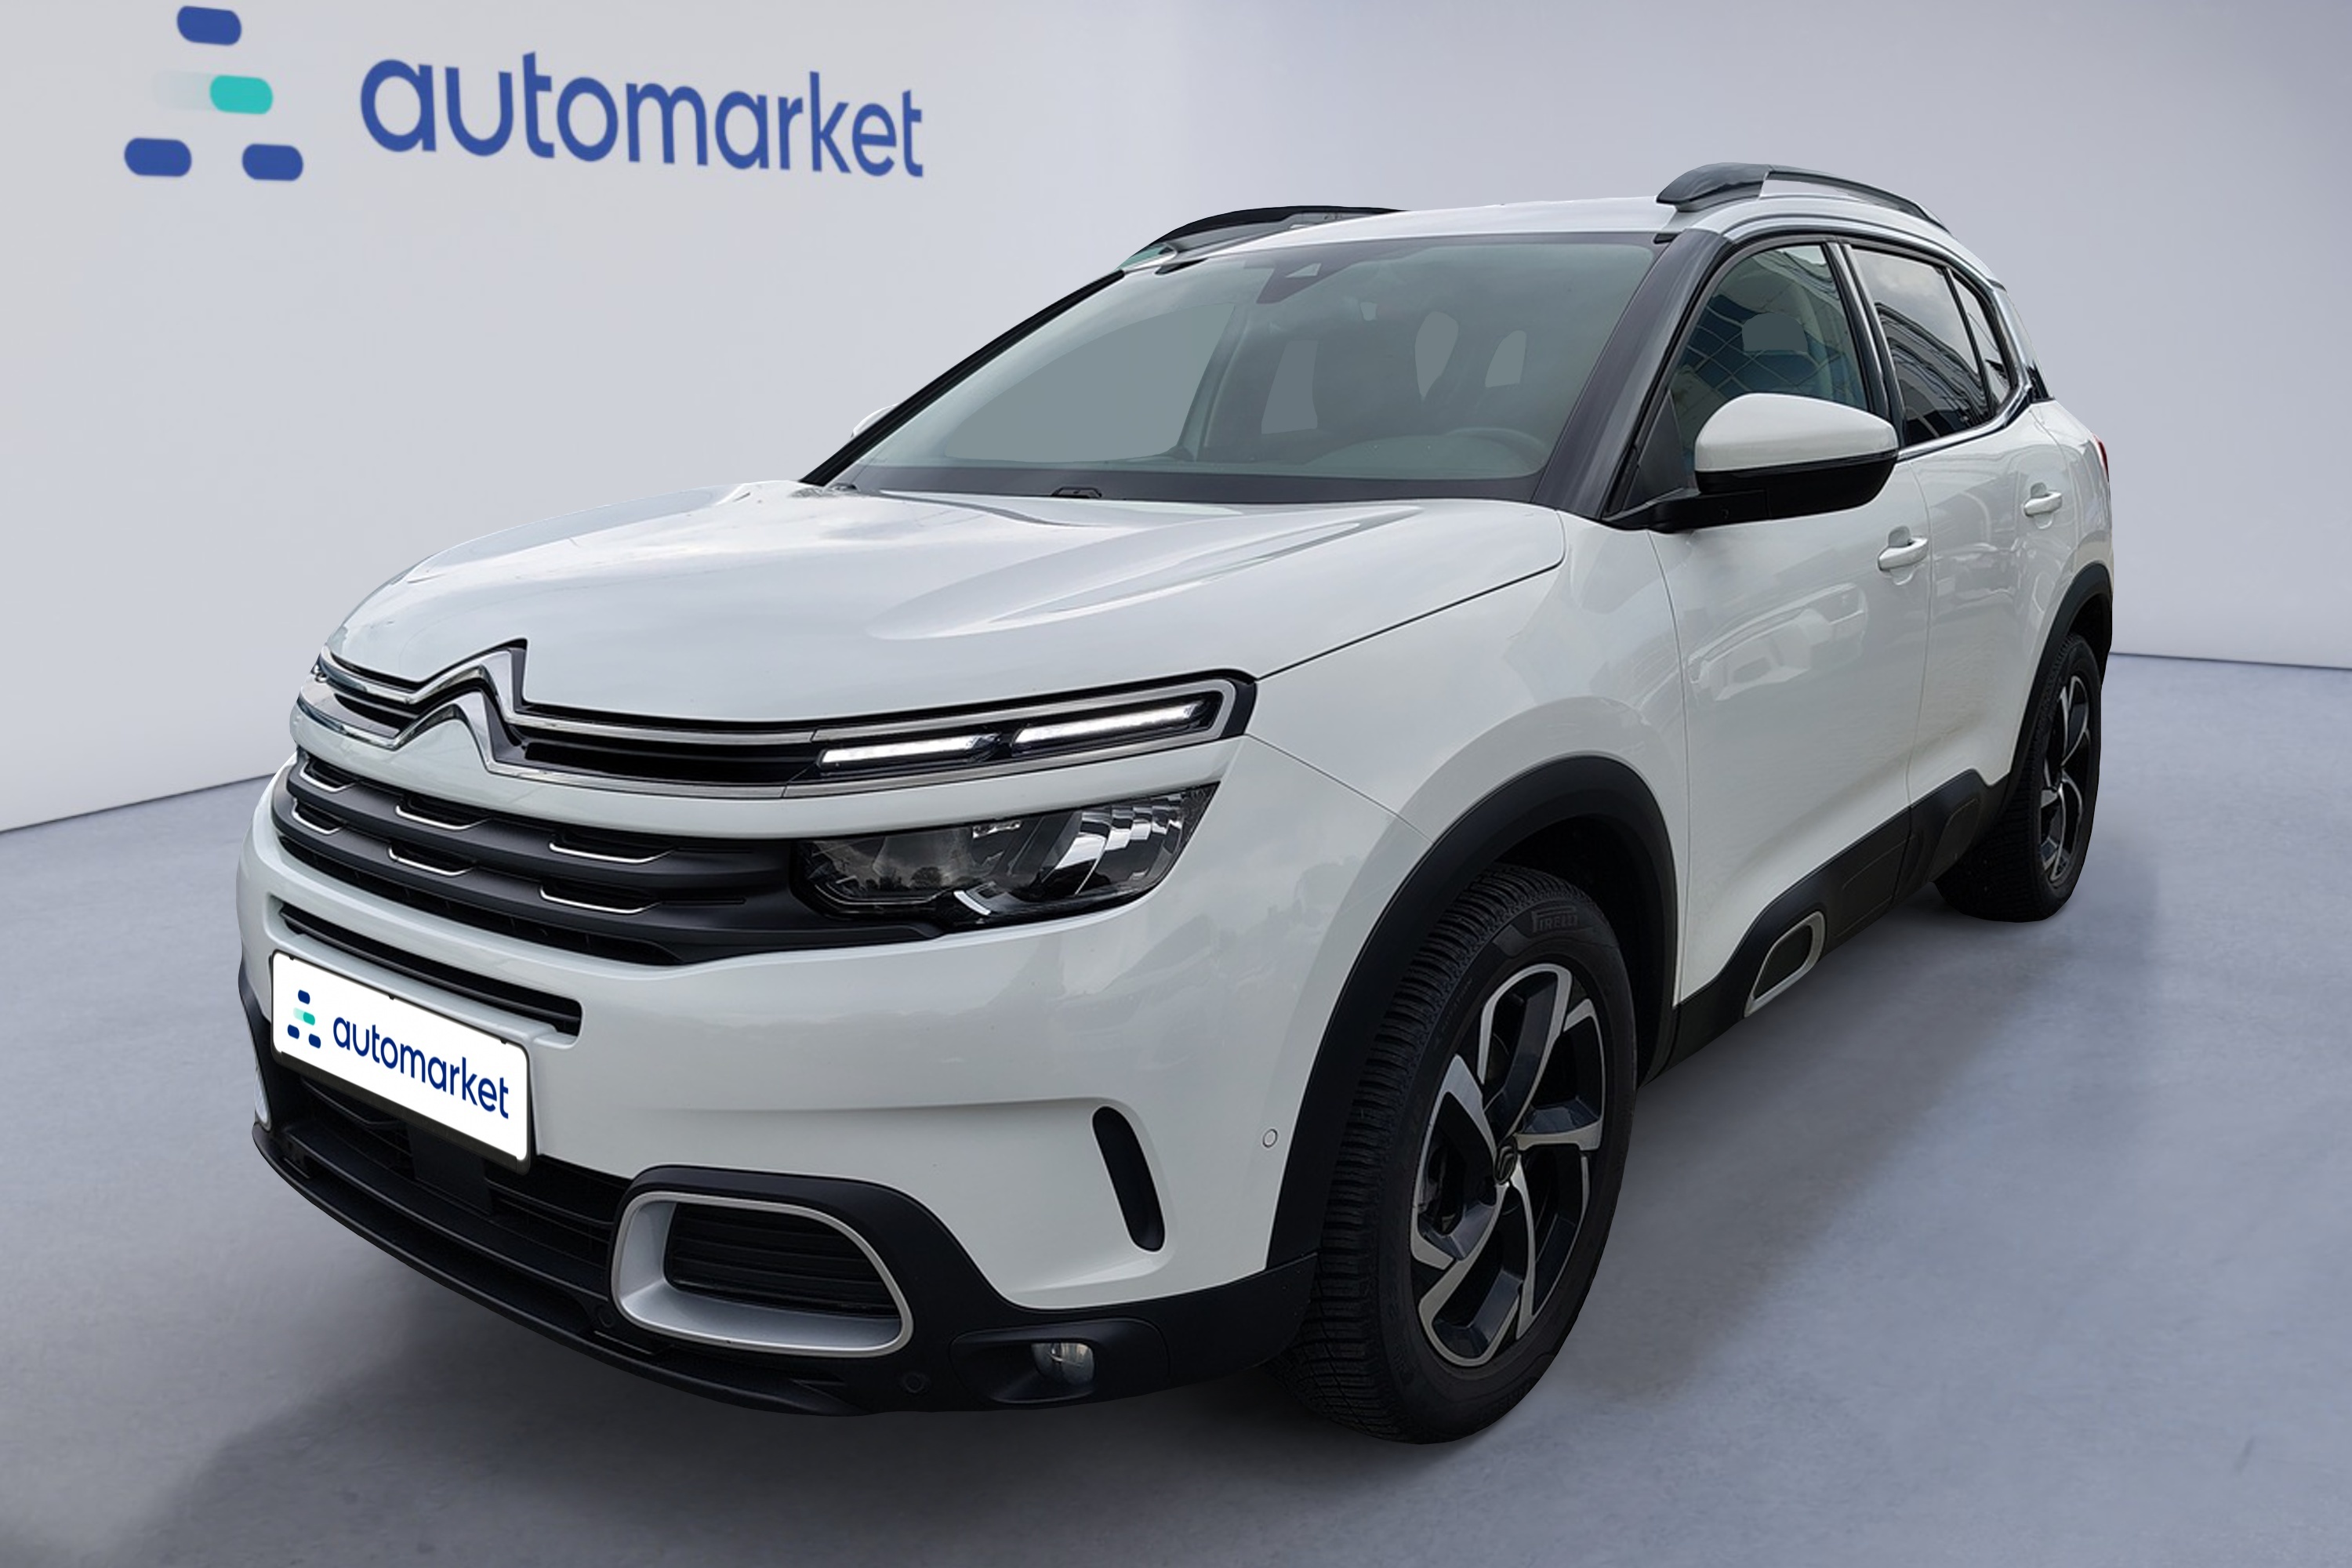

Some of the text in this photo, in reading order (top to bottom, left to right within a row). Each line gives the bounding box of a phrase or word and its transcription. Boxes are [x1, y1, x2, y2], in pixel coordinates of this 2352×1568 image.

[361, 53, 924, 178] automarket
[1531, 906, 1578, 933] PIRELLI
[332, 1016, 509, 1119] automarket
